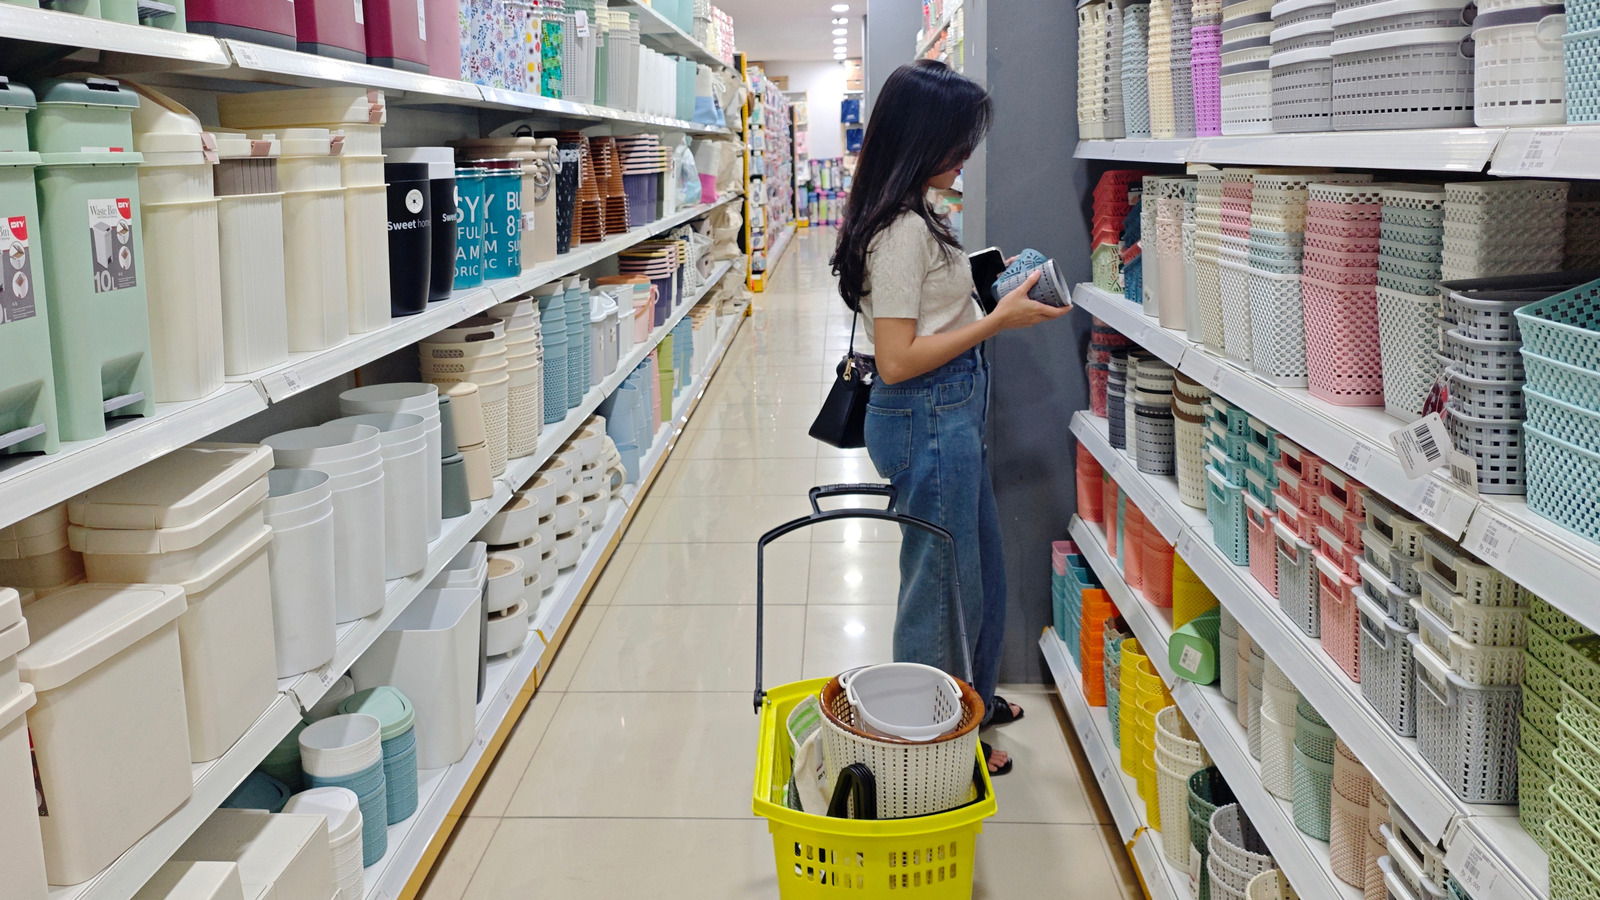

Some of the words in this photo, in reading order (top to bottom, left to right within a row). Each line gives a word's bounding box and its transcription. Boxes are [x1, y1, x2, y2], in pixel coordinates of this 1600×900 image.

[90, 205, 107, 215] Waste
[107, 205, 118, 214] Bin
[387, 220, 417, 231] Sweet
